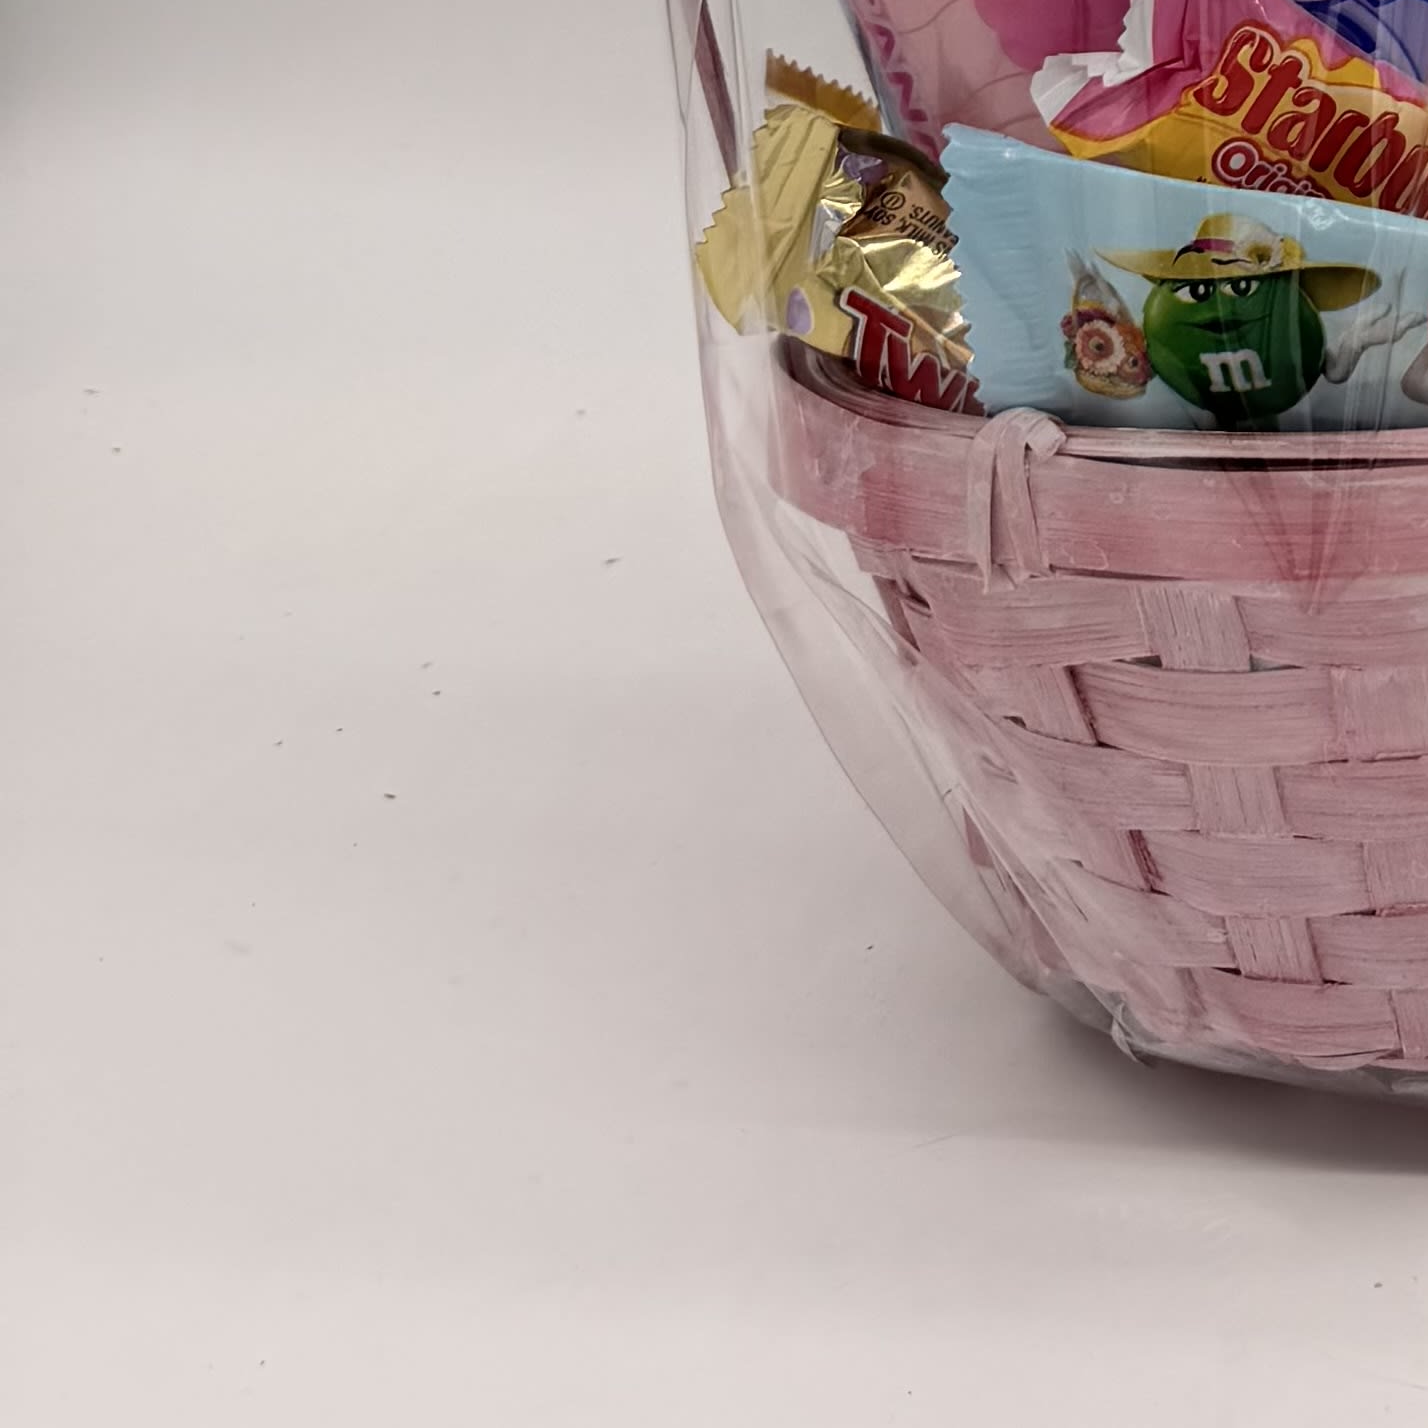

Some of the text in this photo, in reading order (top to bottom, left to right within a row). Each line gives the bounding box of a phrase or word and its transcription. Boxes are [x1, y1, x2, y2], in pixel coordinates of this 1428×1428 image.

[1215, 141, 1331, 201] Orig
[844, 289, 985, 417] TW
[1200, 349, 1272, 393] m
